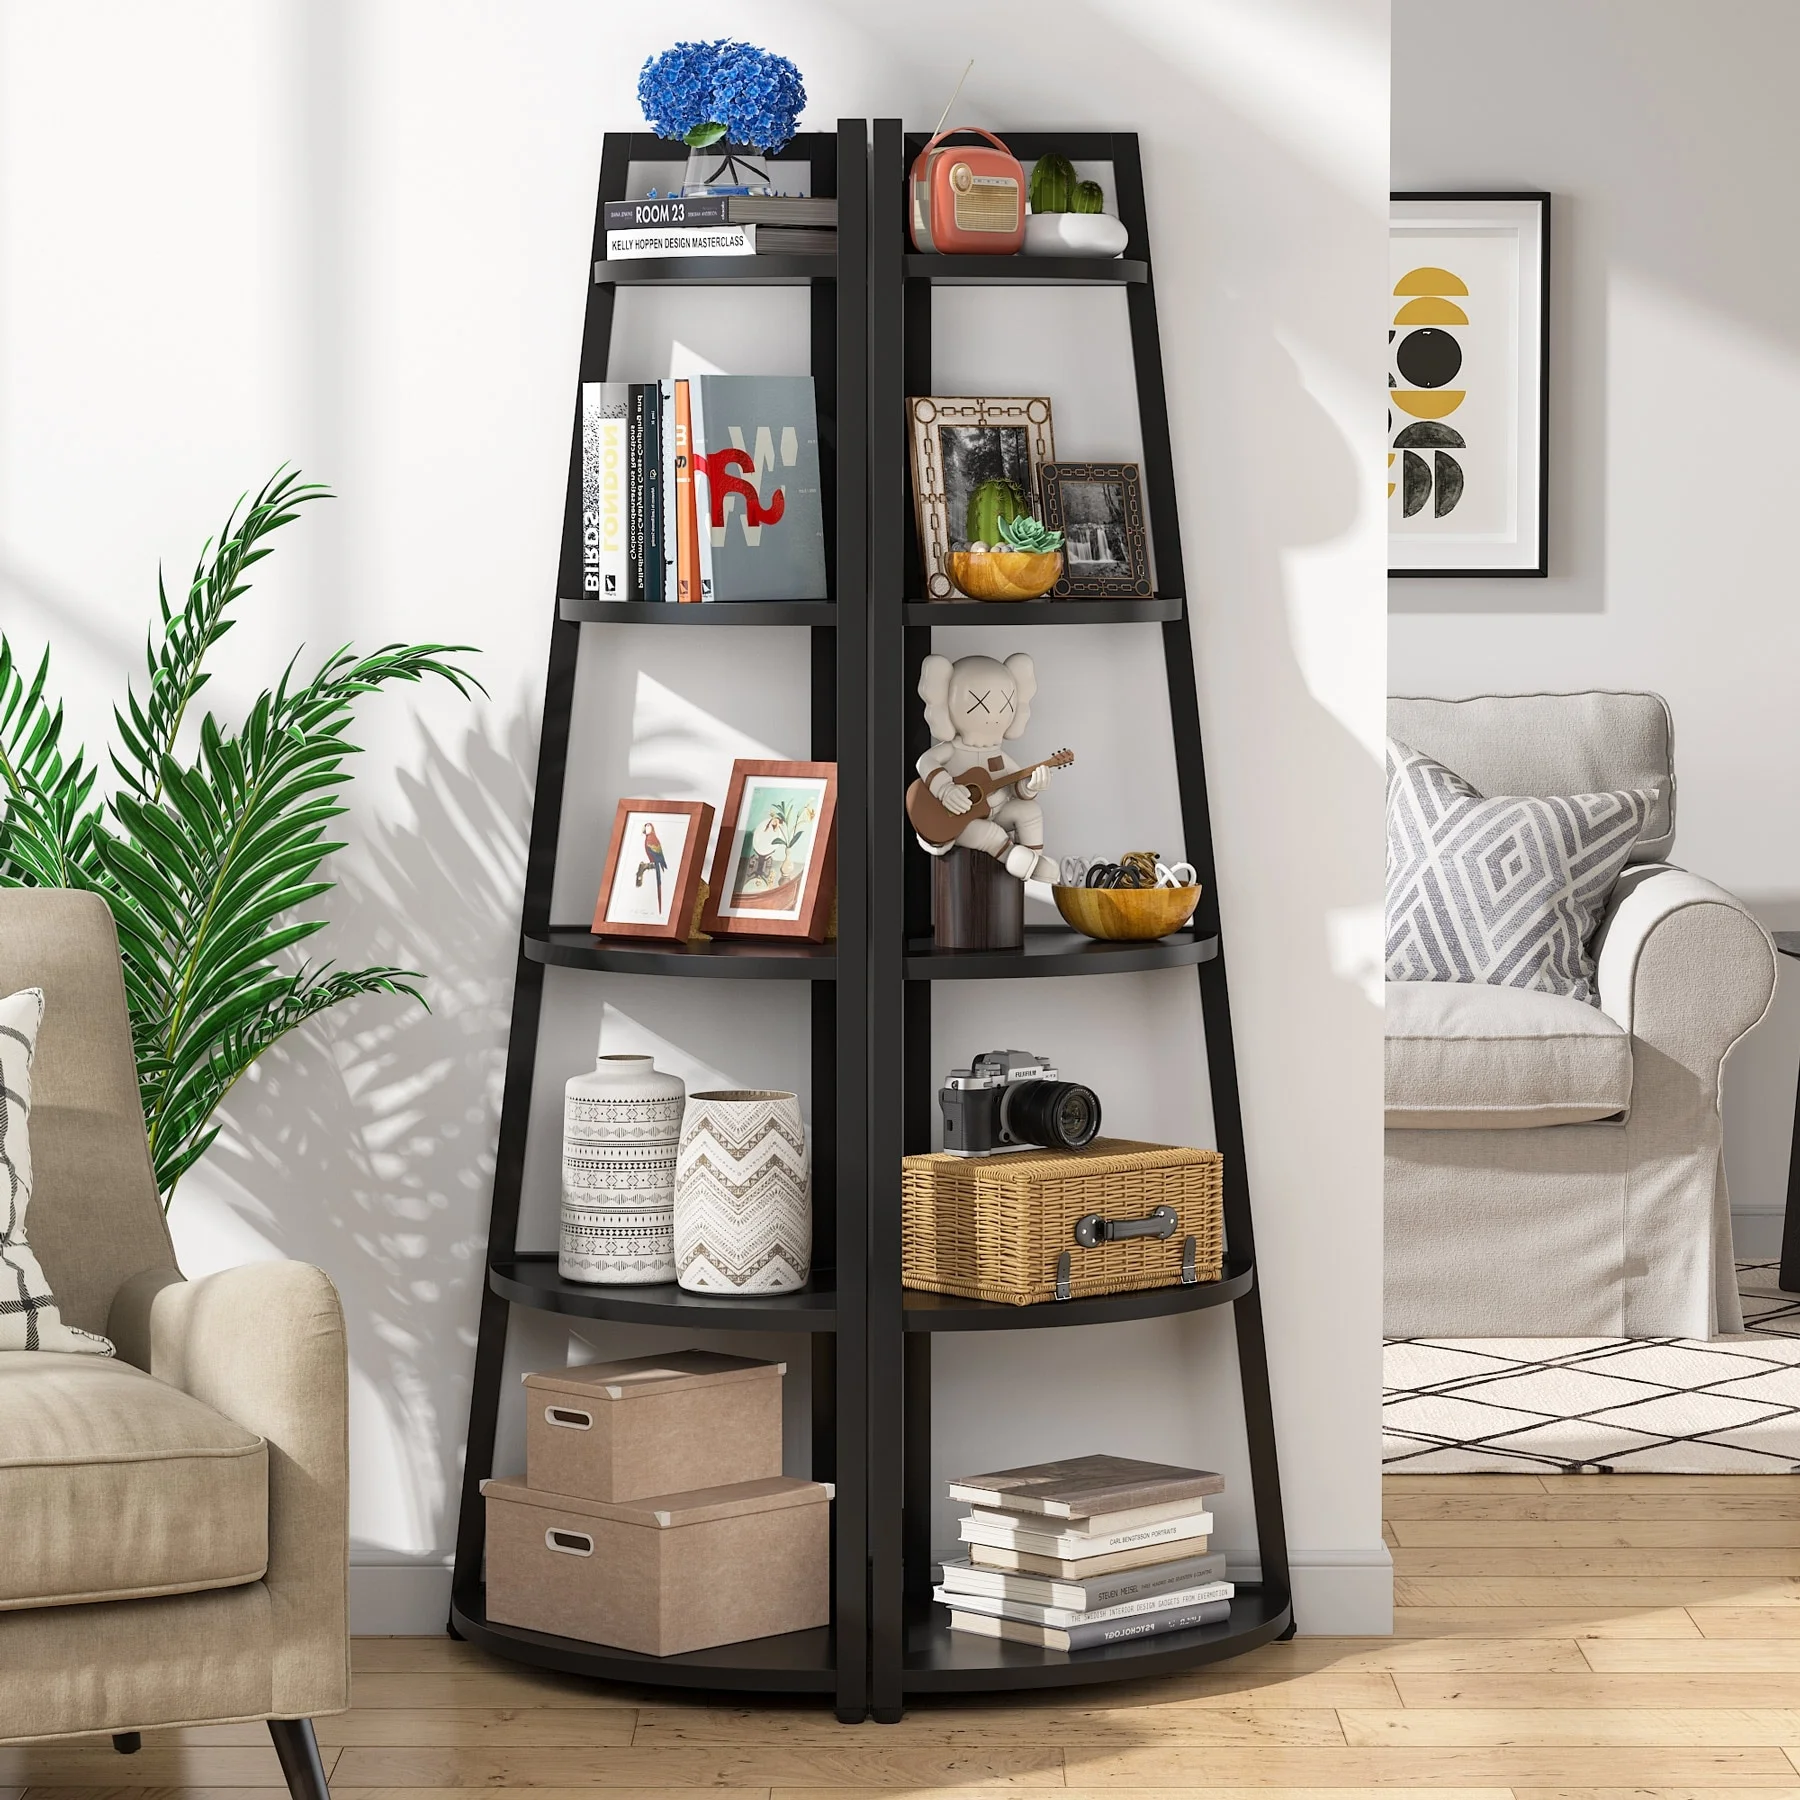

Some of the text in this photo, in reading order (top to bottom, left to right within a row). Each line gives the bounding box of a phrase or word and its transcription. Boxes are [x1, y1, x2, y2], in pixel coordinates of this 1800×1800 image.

[636, 204, 685, 224] ROOM 23
[612, 235, 744, 251] KELLY HOPPEN DESIGN MASTERCLASS
[1015, 1070, 1036, 1078] FUJIFILM
[1109, 1527, 1177, 1546] CARL BENGTSSON PORTRAITS
[1098, 1590, 1118, 1601] STEVEN
[1120, 1585, 1139, 1596] MEISEL
[1071, 1588, 1228, 1623] THE SWEDISH INTERIOR DESIGN GADGETS FROM EVERMOTION
